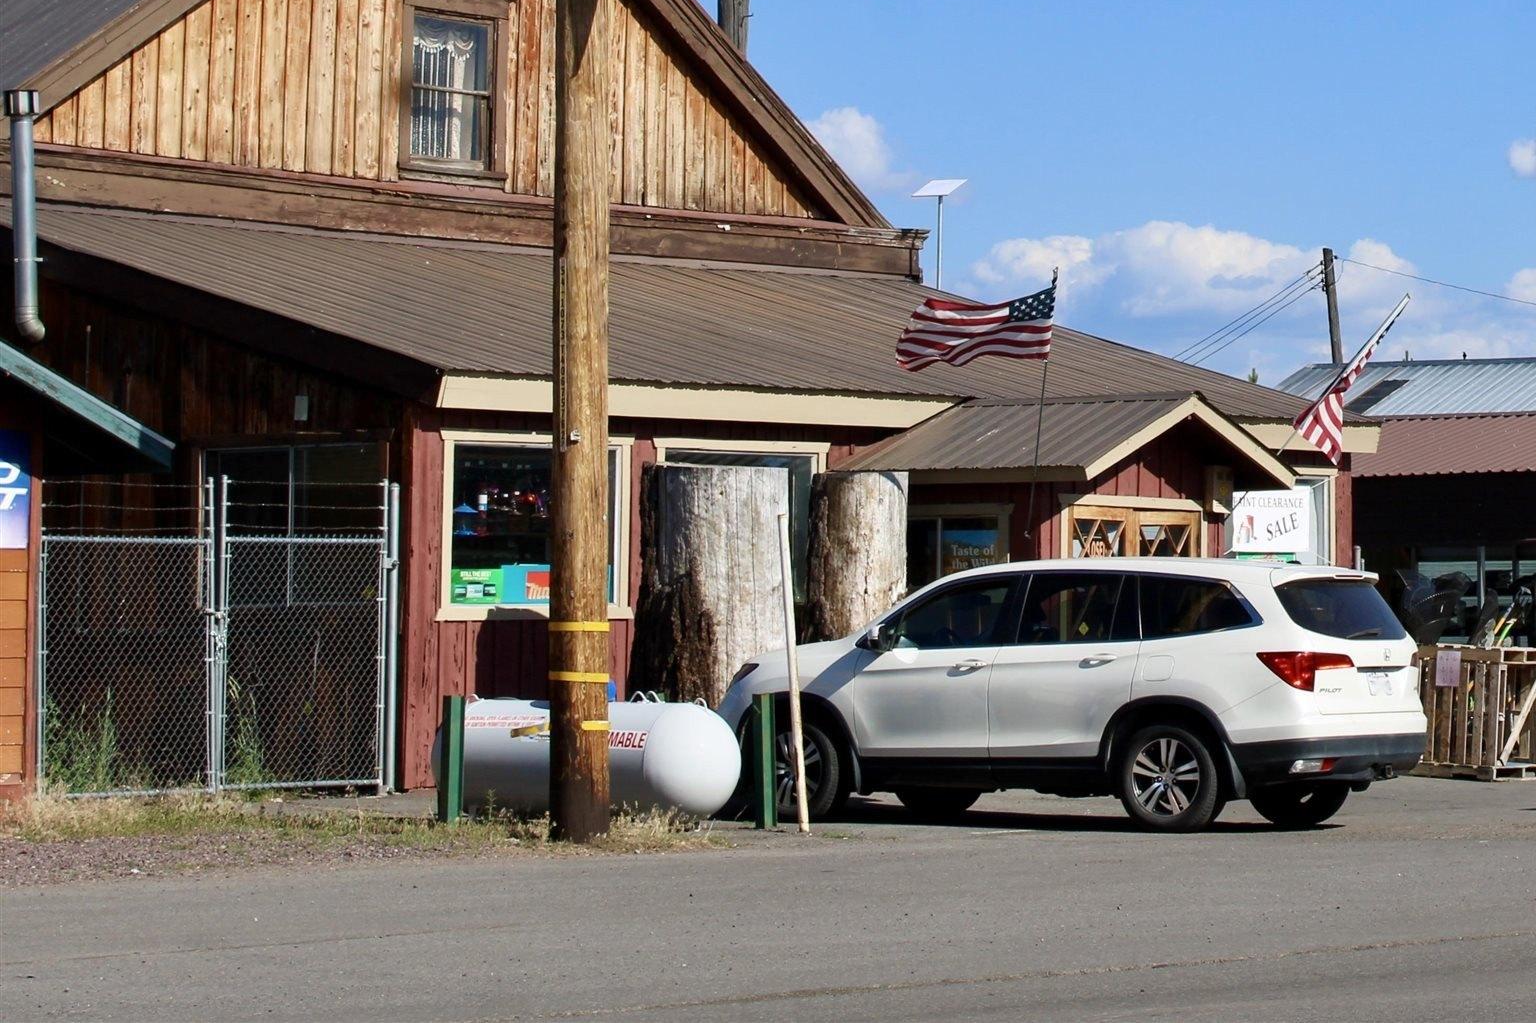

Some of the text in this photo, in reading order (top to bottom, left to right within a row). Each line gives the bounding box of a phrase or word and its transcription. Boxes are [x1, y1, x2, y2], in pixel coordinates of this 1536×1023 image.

[1258, 496, 1304, 509] CLEARANCE
[1266, 511, 1299, 542] SALE
[951, 543, 995, 556] Taste of
[952, 557, 969, 569] the
[608, 731, 648, 749] MABLE
